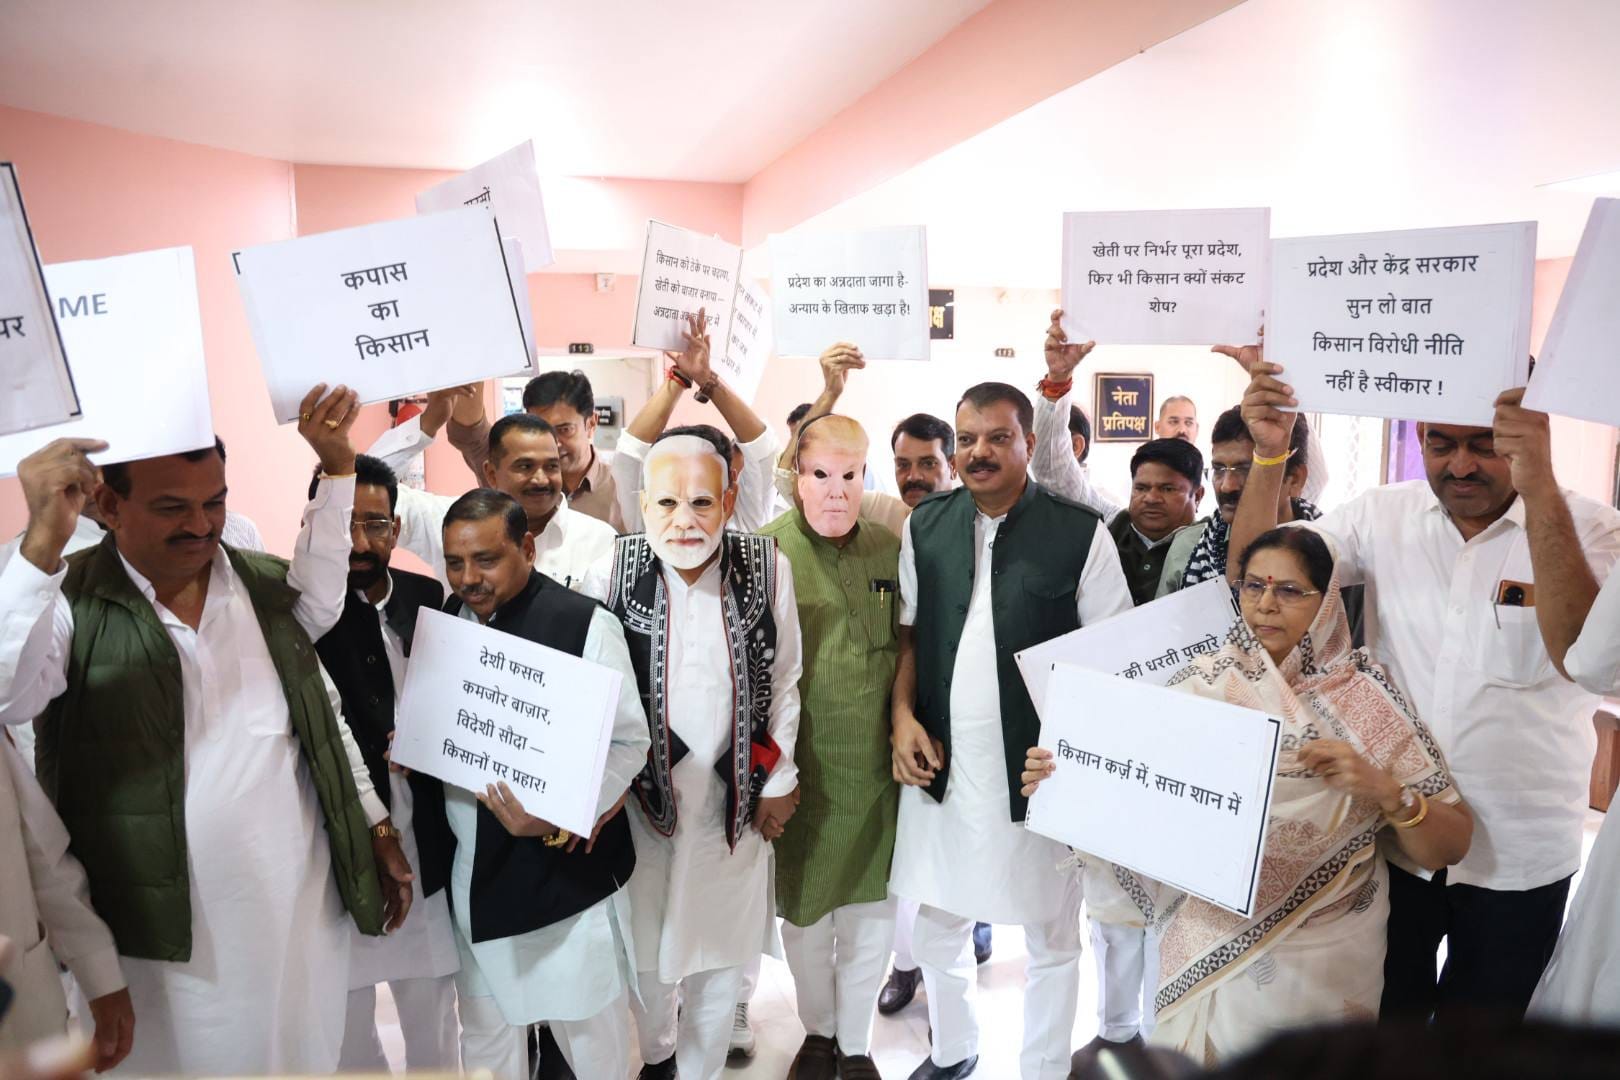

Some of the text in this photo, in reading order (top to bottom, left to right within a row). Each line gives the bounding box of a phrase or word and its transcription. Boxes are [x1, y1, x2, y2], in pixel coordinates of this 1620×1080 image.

[656, 249, 678, 270] किसान
[702, 265, 711, 276] पर
[1092, 240, 1242, 260] खेती पर निर्भर पूरा प्रदेश,
[340, 262, 408, 290] कपास
[1088, 268, 1246, 285] फिर भी किसान क्यों संकट
[1308, 252, 1480, 278] प्रदेश और केंद्र सरकार
[655, 276, 669, 292] खेती
[670, 280, 680, 294] को
[788, 274, 810, 289] प्रदेश
[814, 276, 826, 288] का
[830, 276, 866, 288] अन्नदाता
[869, 276, 894, 288] जागा
[58, 293, 108, 318] ME
[368, 300, 399, 320] का
[789, 303, 818, 315] अन्याय
[822, 300, 831, 314] के
[835, 300, 869, 315] खिलाफ
[872, 303, 896, 317] खड़ा
[1346, 299, 1372, 319] सुन
[1378, 292, 1396, 314] लो
[355, 329, 430, 360] किसान
[1313, 331, 1464, 356] किसान विरोधी नीति
[1325, 370, 1355, 392] नहीं
[1358, 370, 1369, 392] है
[1374, 372, 1432, 394] स्वीकार
[1111, 386, 1139, 406] नेता
[1102, 412, 1146, 434] प्रतिपक्ष
[480, 646, 546, 687] देशी फसल,
[1122, 662, 1143, 680] की
[1146, 648, 1180, 672] धरती
[463, 680, 509, 707] कमजोर
[457, 708, 496, 738] विदेशी
[499, 725, 528, 750] सौदा
[442, 738, 547, 794] किसानों पर प्रहार!
[1058, 739, 1101, 770] किसान
[1105, 758, 1132, 780] कर्ज़
[1154, 774, 1186, 798] सत्ता
[1190, 784, 1224, 810] शान
[1227, 792, 1243, 816] में
